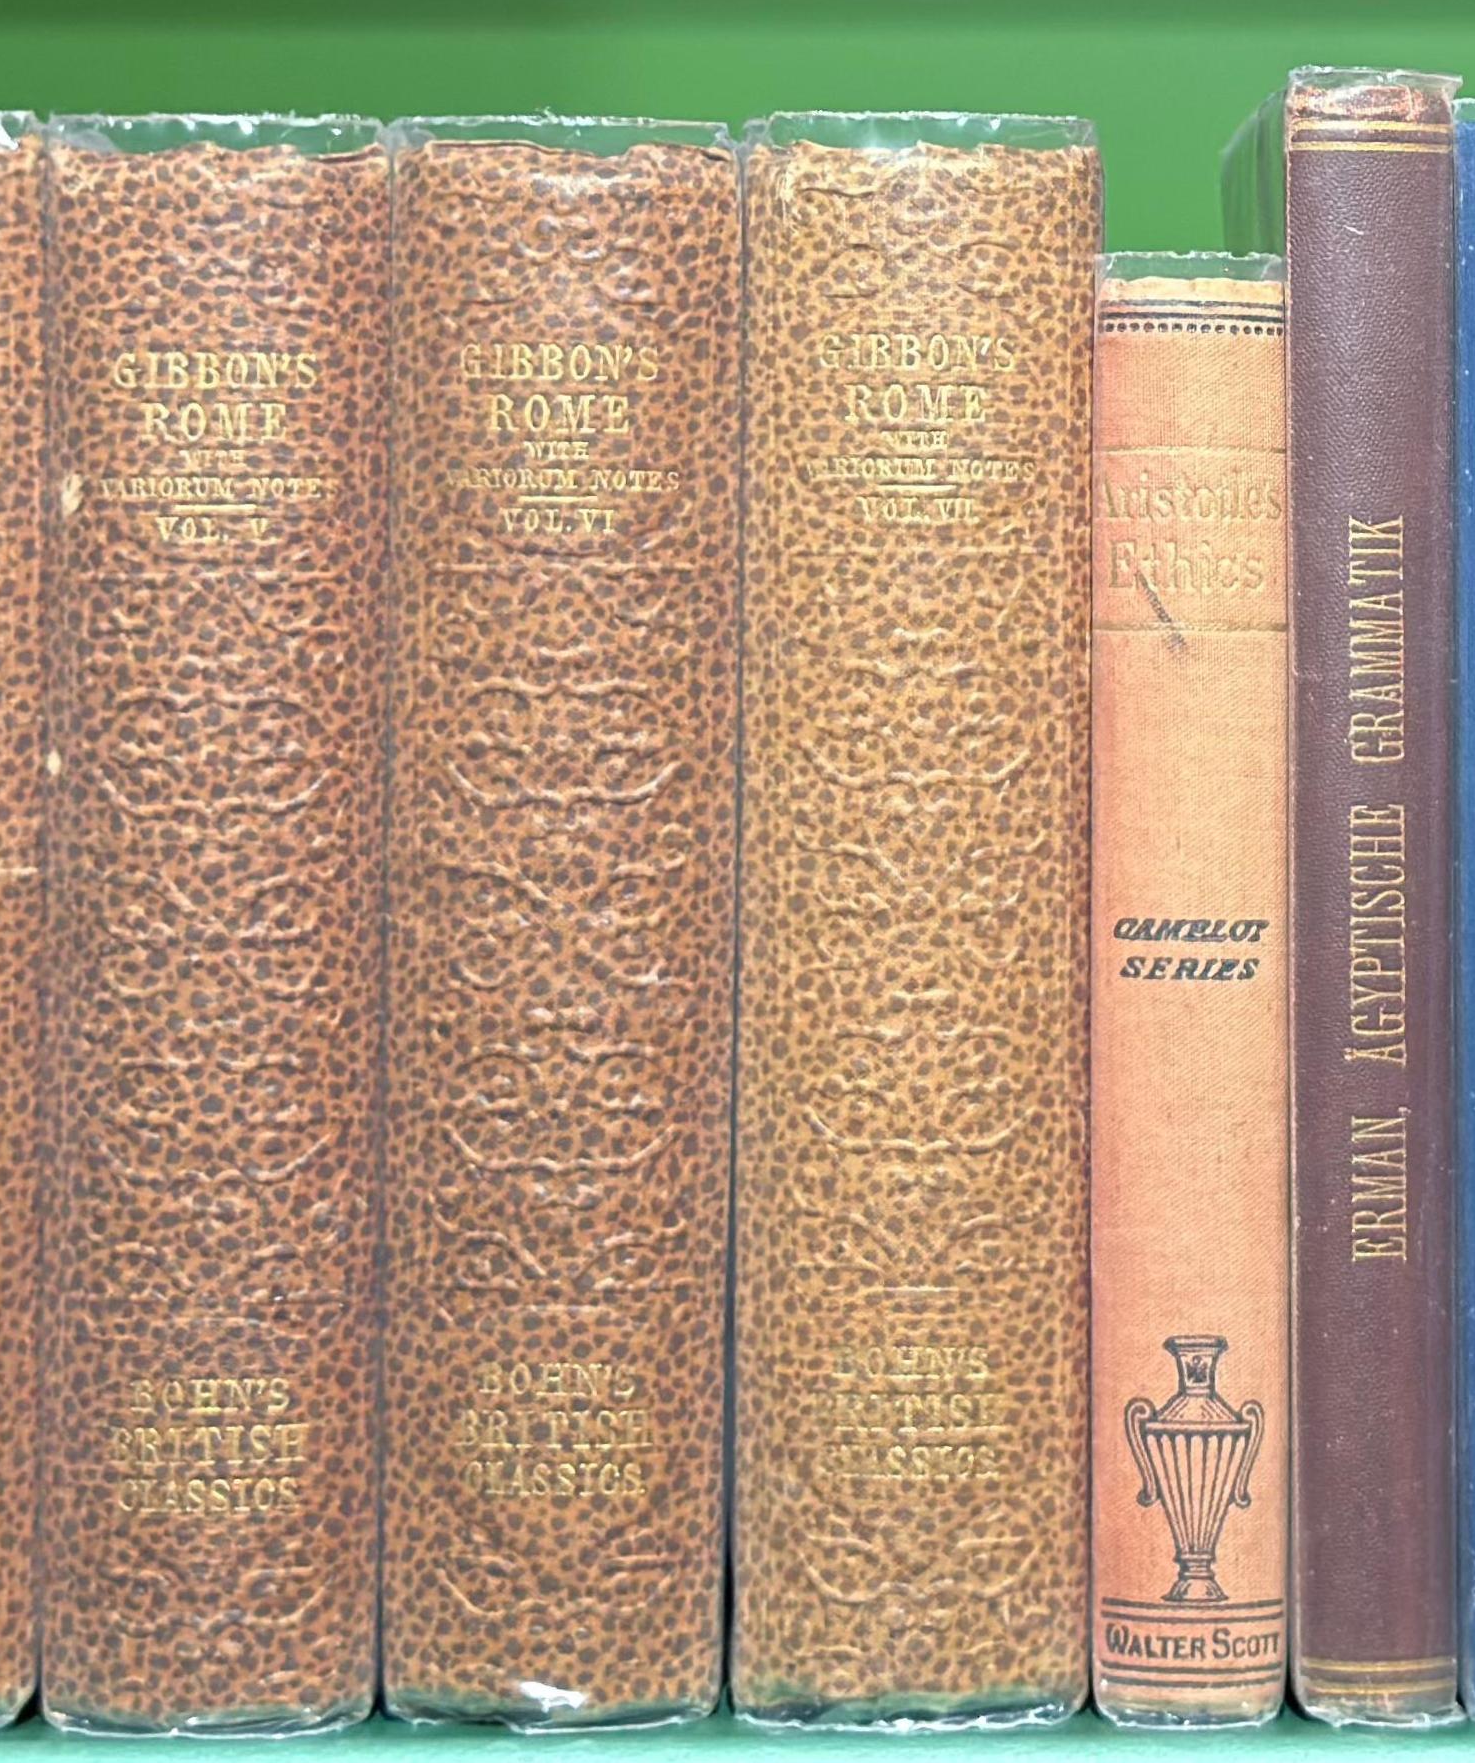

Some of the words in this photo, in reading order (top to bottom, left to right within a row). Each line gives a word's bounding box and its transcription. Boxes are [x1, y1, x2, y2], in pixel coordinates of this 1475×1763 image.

[113, 351, 317, 389] GIBBON'S
[460, 343, 660, 381] GIBBON'S
[819, 333, 1017, 371] GIBBON'S
[490, 394, 631, 434] ROME
[844, 384, 987, 424] ROME
[140, 401, 287, 444] ROME
[881, 430, 947, 449] WITH
[179, 449, 249, 470] WITH
[522, 441, 590, 461] WITH
[948, 457, 1038, 481] NOTES
[100, 476, 236, 498] VARIORUM
[246, 477, 338, 498] NOTES
[445, 468, 578, 490] VARIORUM
[591, 470, 680, 491] NOTES
[501, 508, 573, 533] VOL.
[855, 497, 930, 523] VOL.
[156, 516, 230, 542] VOL.
[1109, 539, 1264, 591] Ethics
[1348, 514, 1404, 765] GRAMMATIK
[1113, 918, 1269, 942] CAMELOT
[1345, 804, 1406, 1067] ÄGYPTISCHE
[1119, 956, 1260, 980] SERIES
[1351, 1106, 1411, 1262] ERMAN,
[129, 1378, 291, 1414] BOHN'S
[479, 1362, 635, 1396] BOHN'S
[111, 1423, 310, 1465] BRITISH
[455, 1409, 654, 1450] BRITISH
[119, 1476, 300, 1512] CLASSICS
[1105, 1623, 1205, 1659] WALTER
